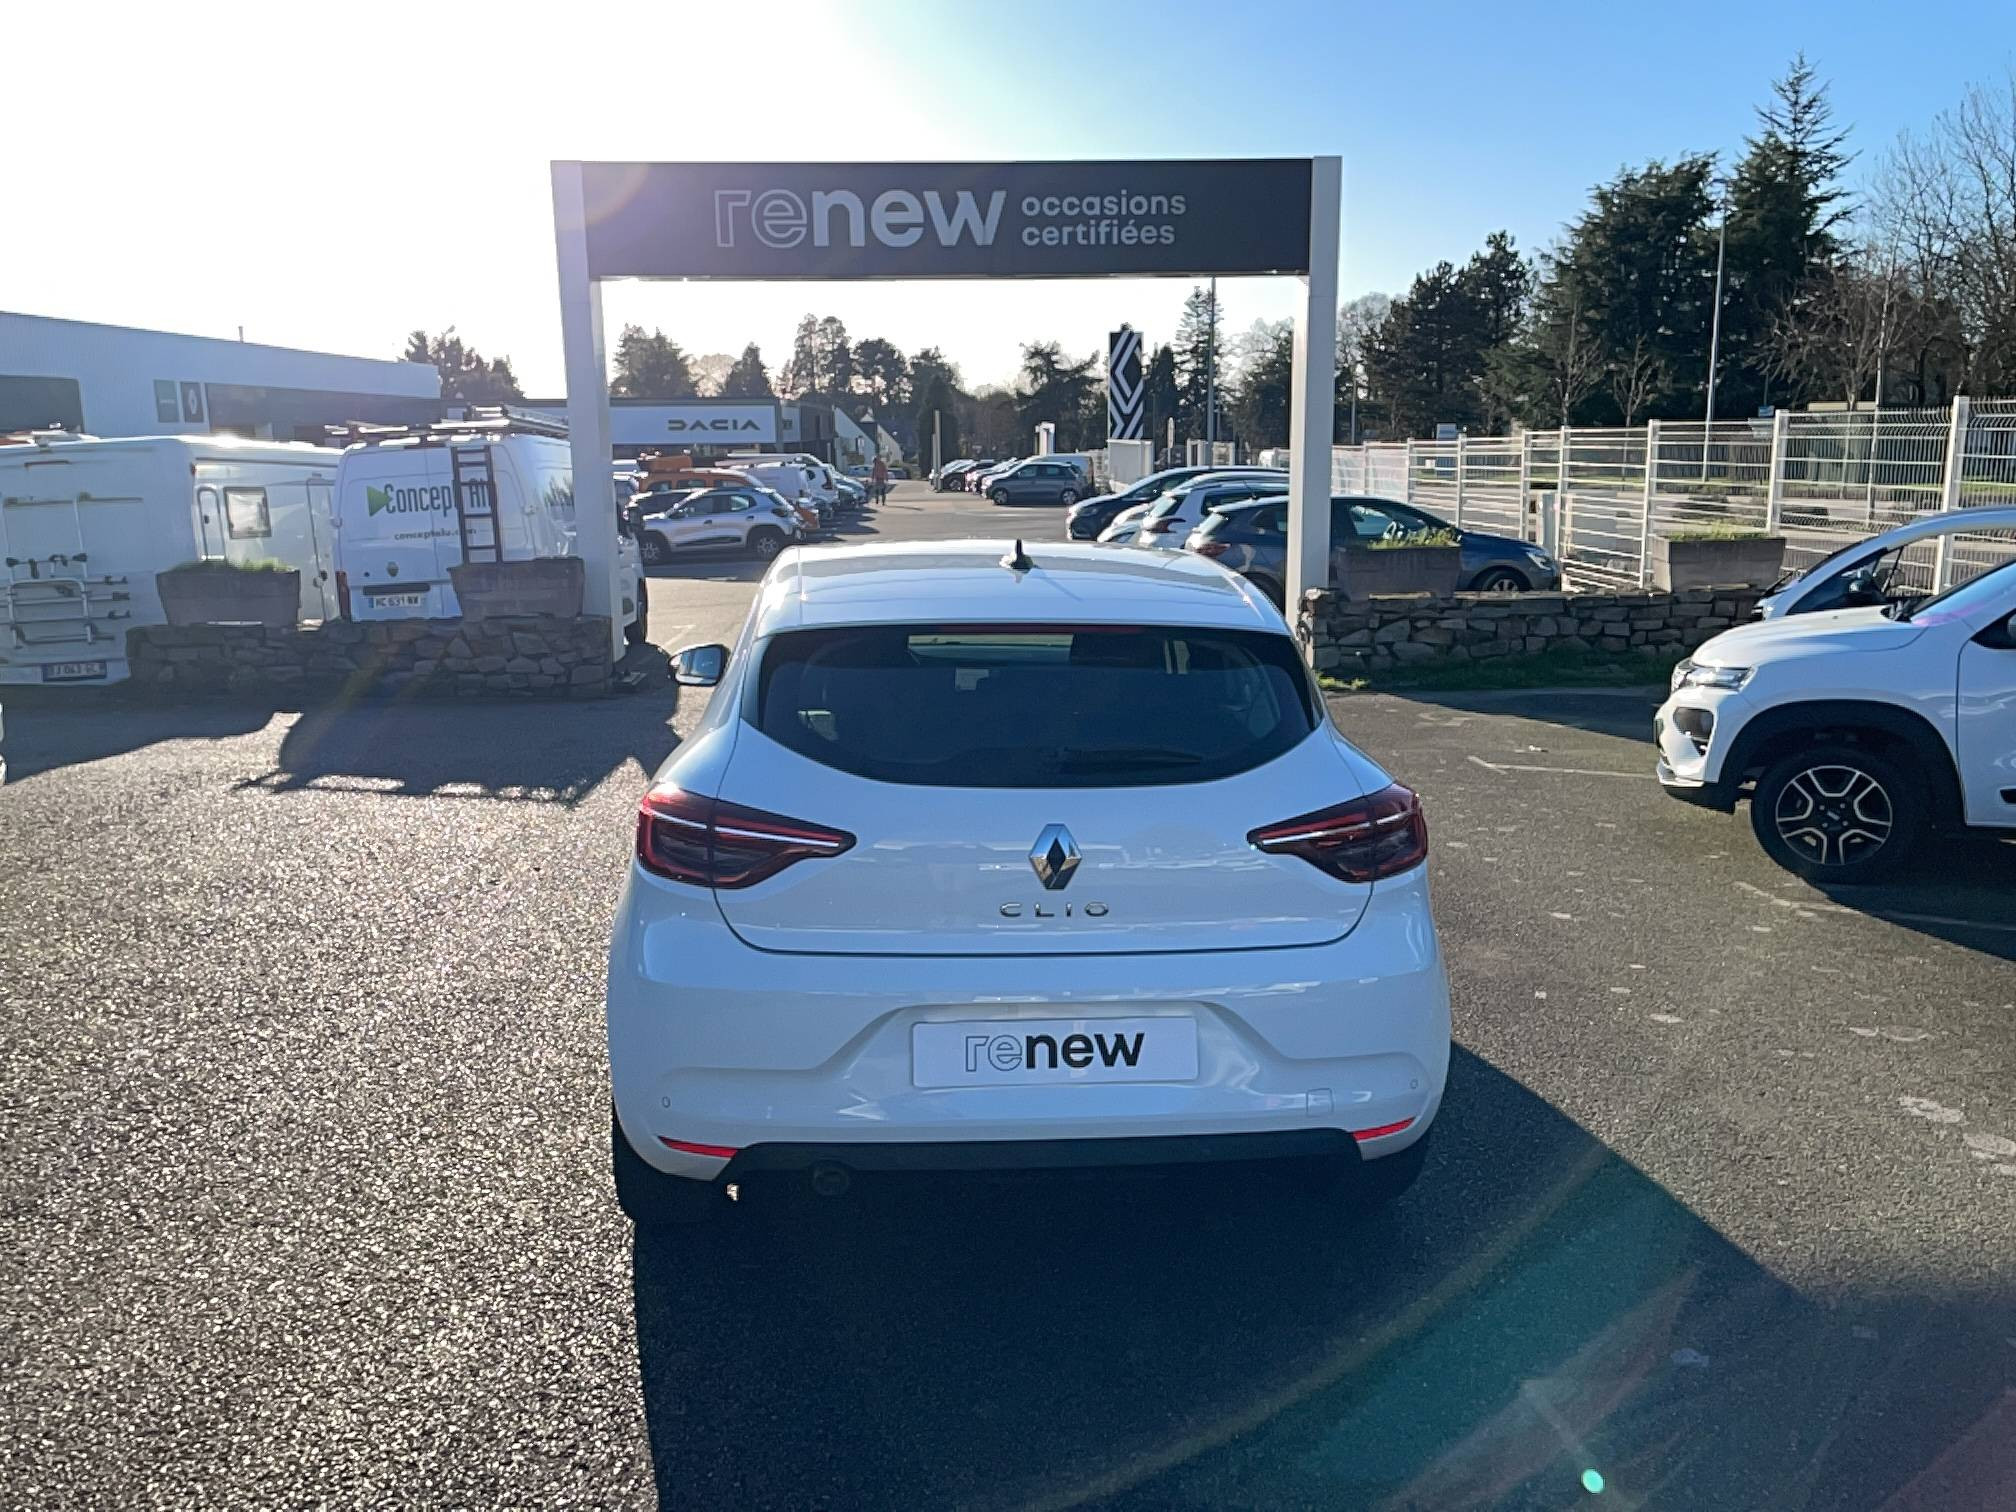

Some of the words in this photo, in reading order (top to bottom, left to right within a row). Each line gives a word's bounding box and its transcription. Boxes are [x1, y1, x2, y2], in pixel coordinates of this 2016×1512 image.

[1021, 190, 1186, 217] occasions
[713, 189, 1007, 248] renew
[1021, 220, 1175, 247] certifiées
[667, 419, 761, 431] DACIA
[1000, 902, 1109, 917] CLIO
[965, 1032, 1145, 1073] renew
